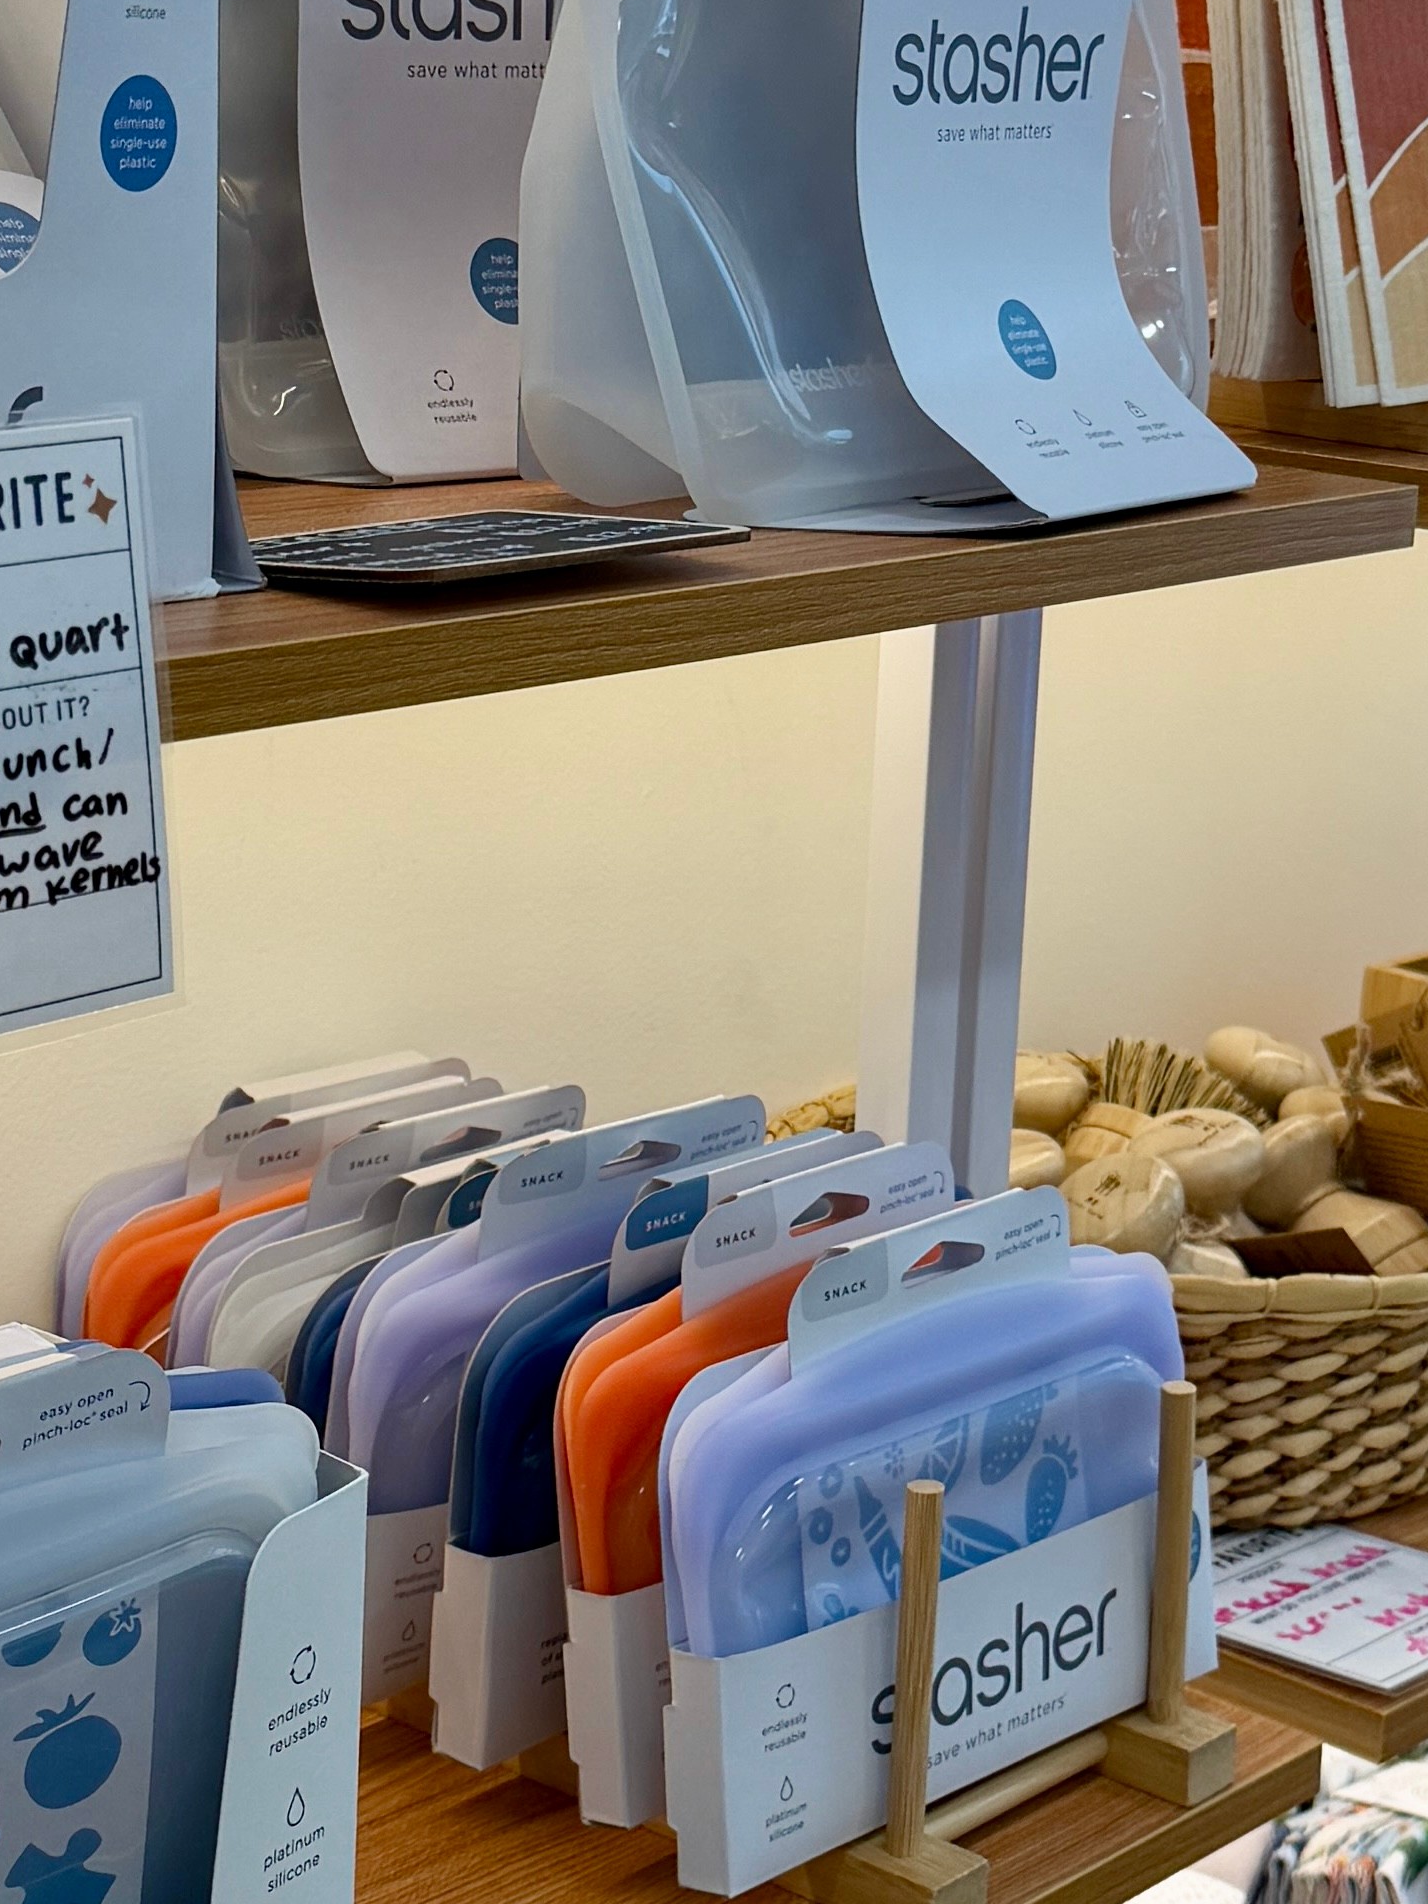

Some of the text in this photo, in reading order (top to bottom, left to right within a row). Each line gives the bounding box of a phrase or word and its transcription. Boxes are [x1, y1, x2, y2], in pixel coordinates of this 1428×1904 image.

[891, 6, 1105, 106] stasher
[127, 96, 154, 114] help
[113, 115, 166, 132] eliminate
[936, 123, 1055, 144] save what matters
[109, 134, 168, 155] single-use
[118, 153, 157, 171] plastic
[52, 695, 91, 725] IT?
[61, 789, 129, 823] can
[46, 852, 162, 907] kernels
[257, 1146, 302, 1168] SNACK
